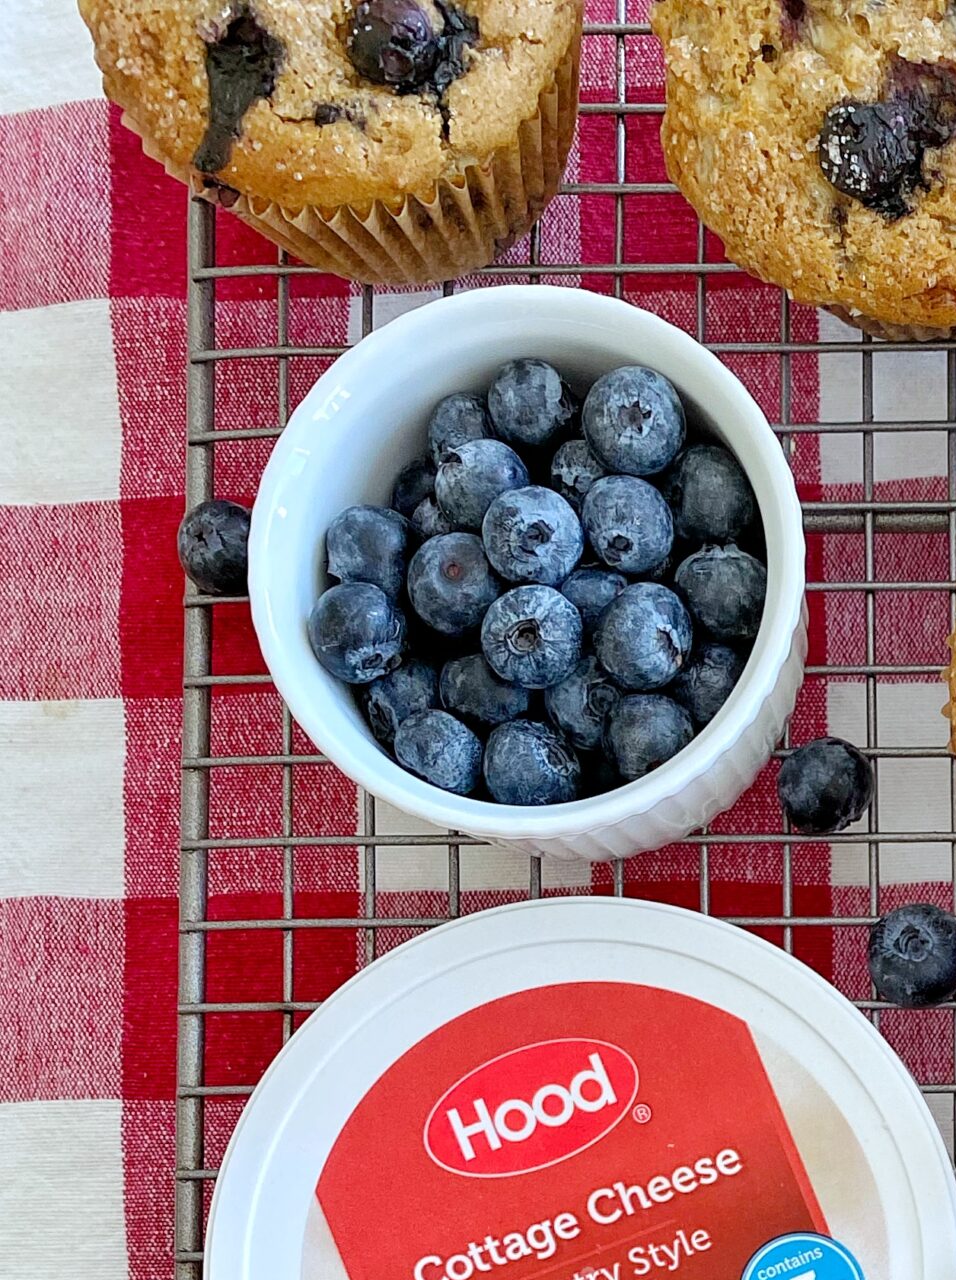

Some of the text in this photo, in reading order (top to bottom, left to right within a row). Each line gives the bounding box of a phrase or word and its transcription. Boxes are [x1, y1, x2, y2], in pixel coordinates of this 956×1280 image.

[446, 1052, 618, 1161] Hood
[587, 1147, 743, 1225] Cheese
[628, 1225, 713, 1275] Style
